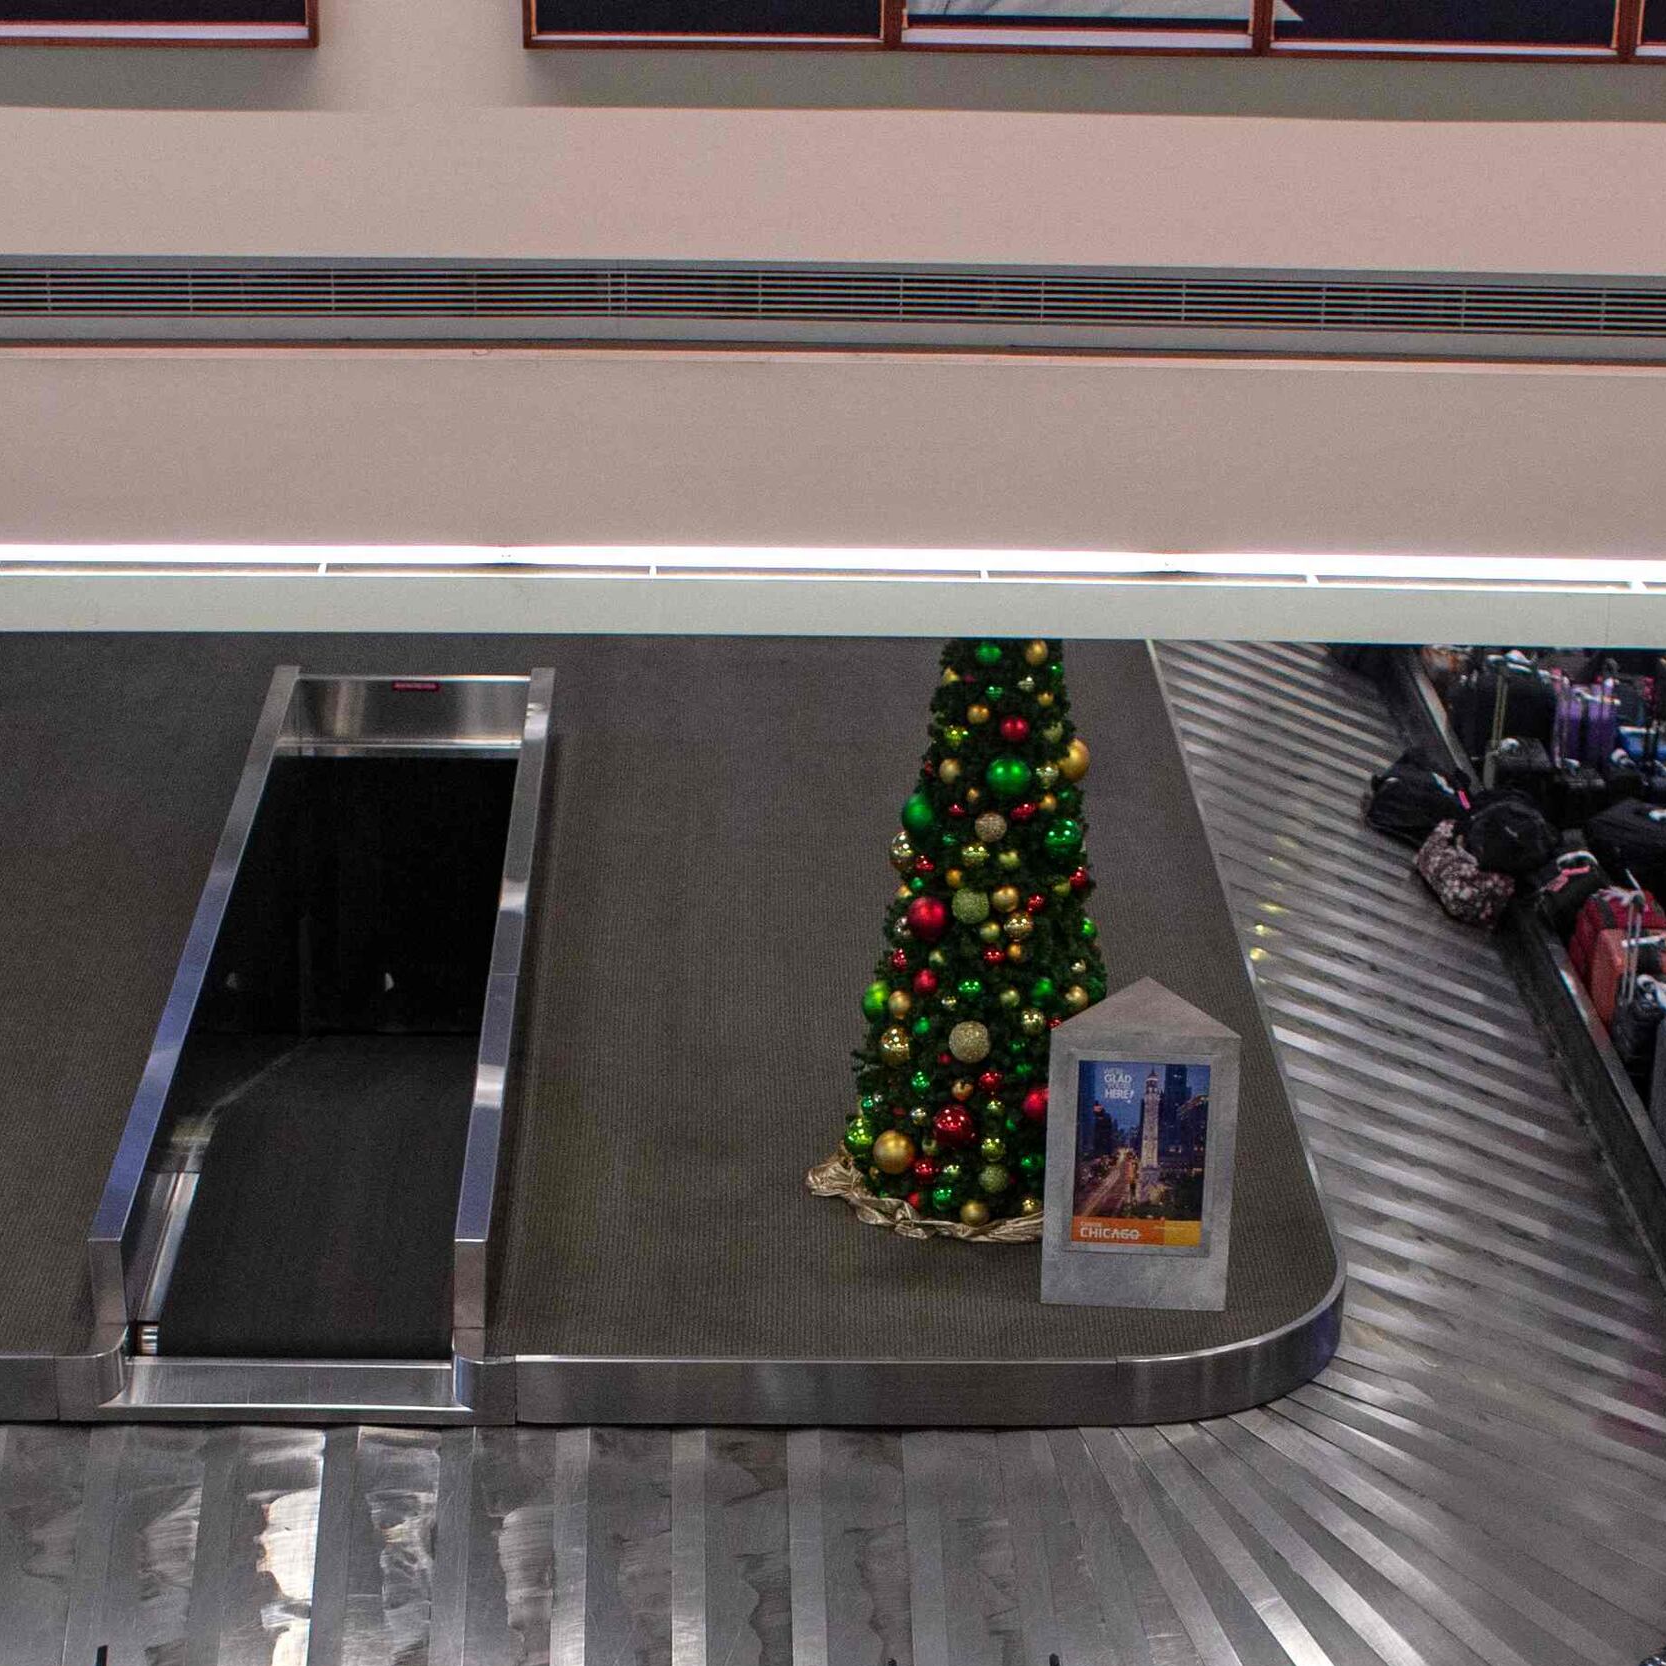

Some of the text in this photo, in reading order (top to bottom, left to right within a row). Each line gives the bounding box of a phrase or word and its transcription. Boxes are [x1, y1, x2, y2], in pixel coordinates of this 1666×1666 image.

[1104, 1074, 1132, 1083] GLAD
[1105, 1089, 1134, 1104] HERE!
[1080, 1227, 1140, 1240] CHICAGO
